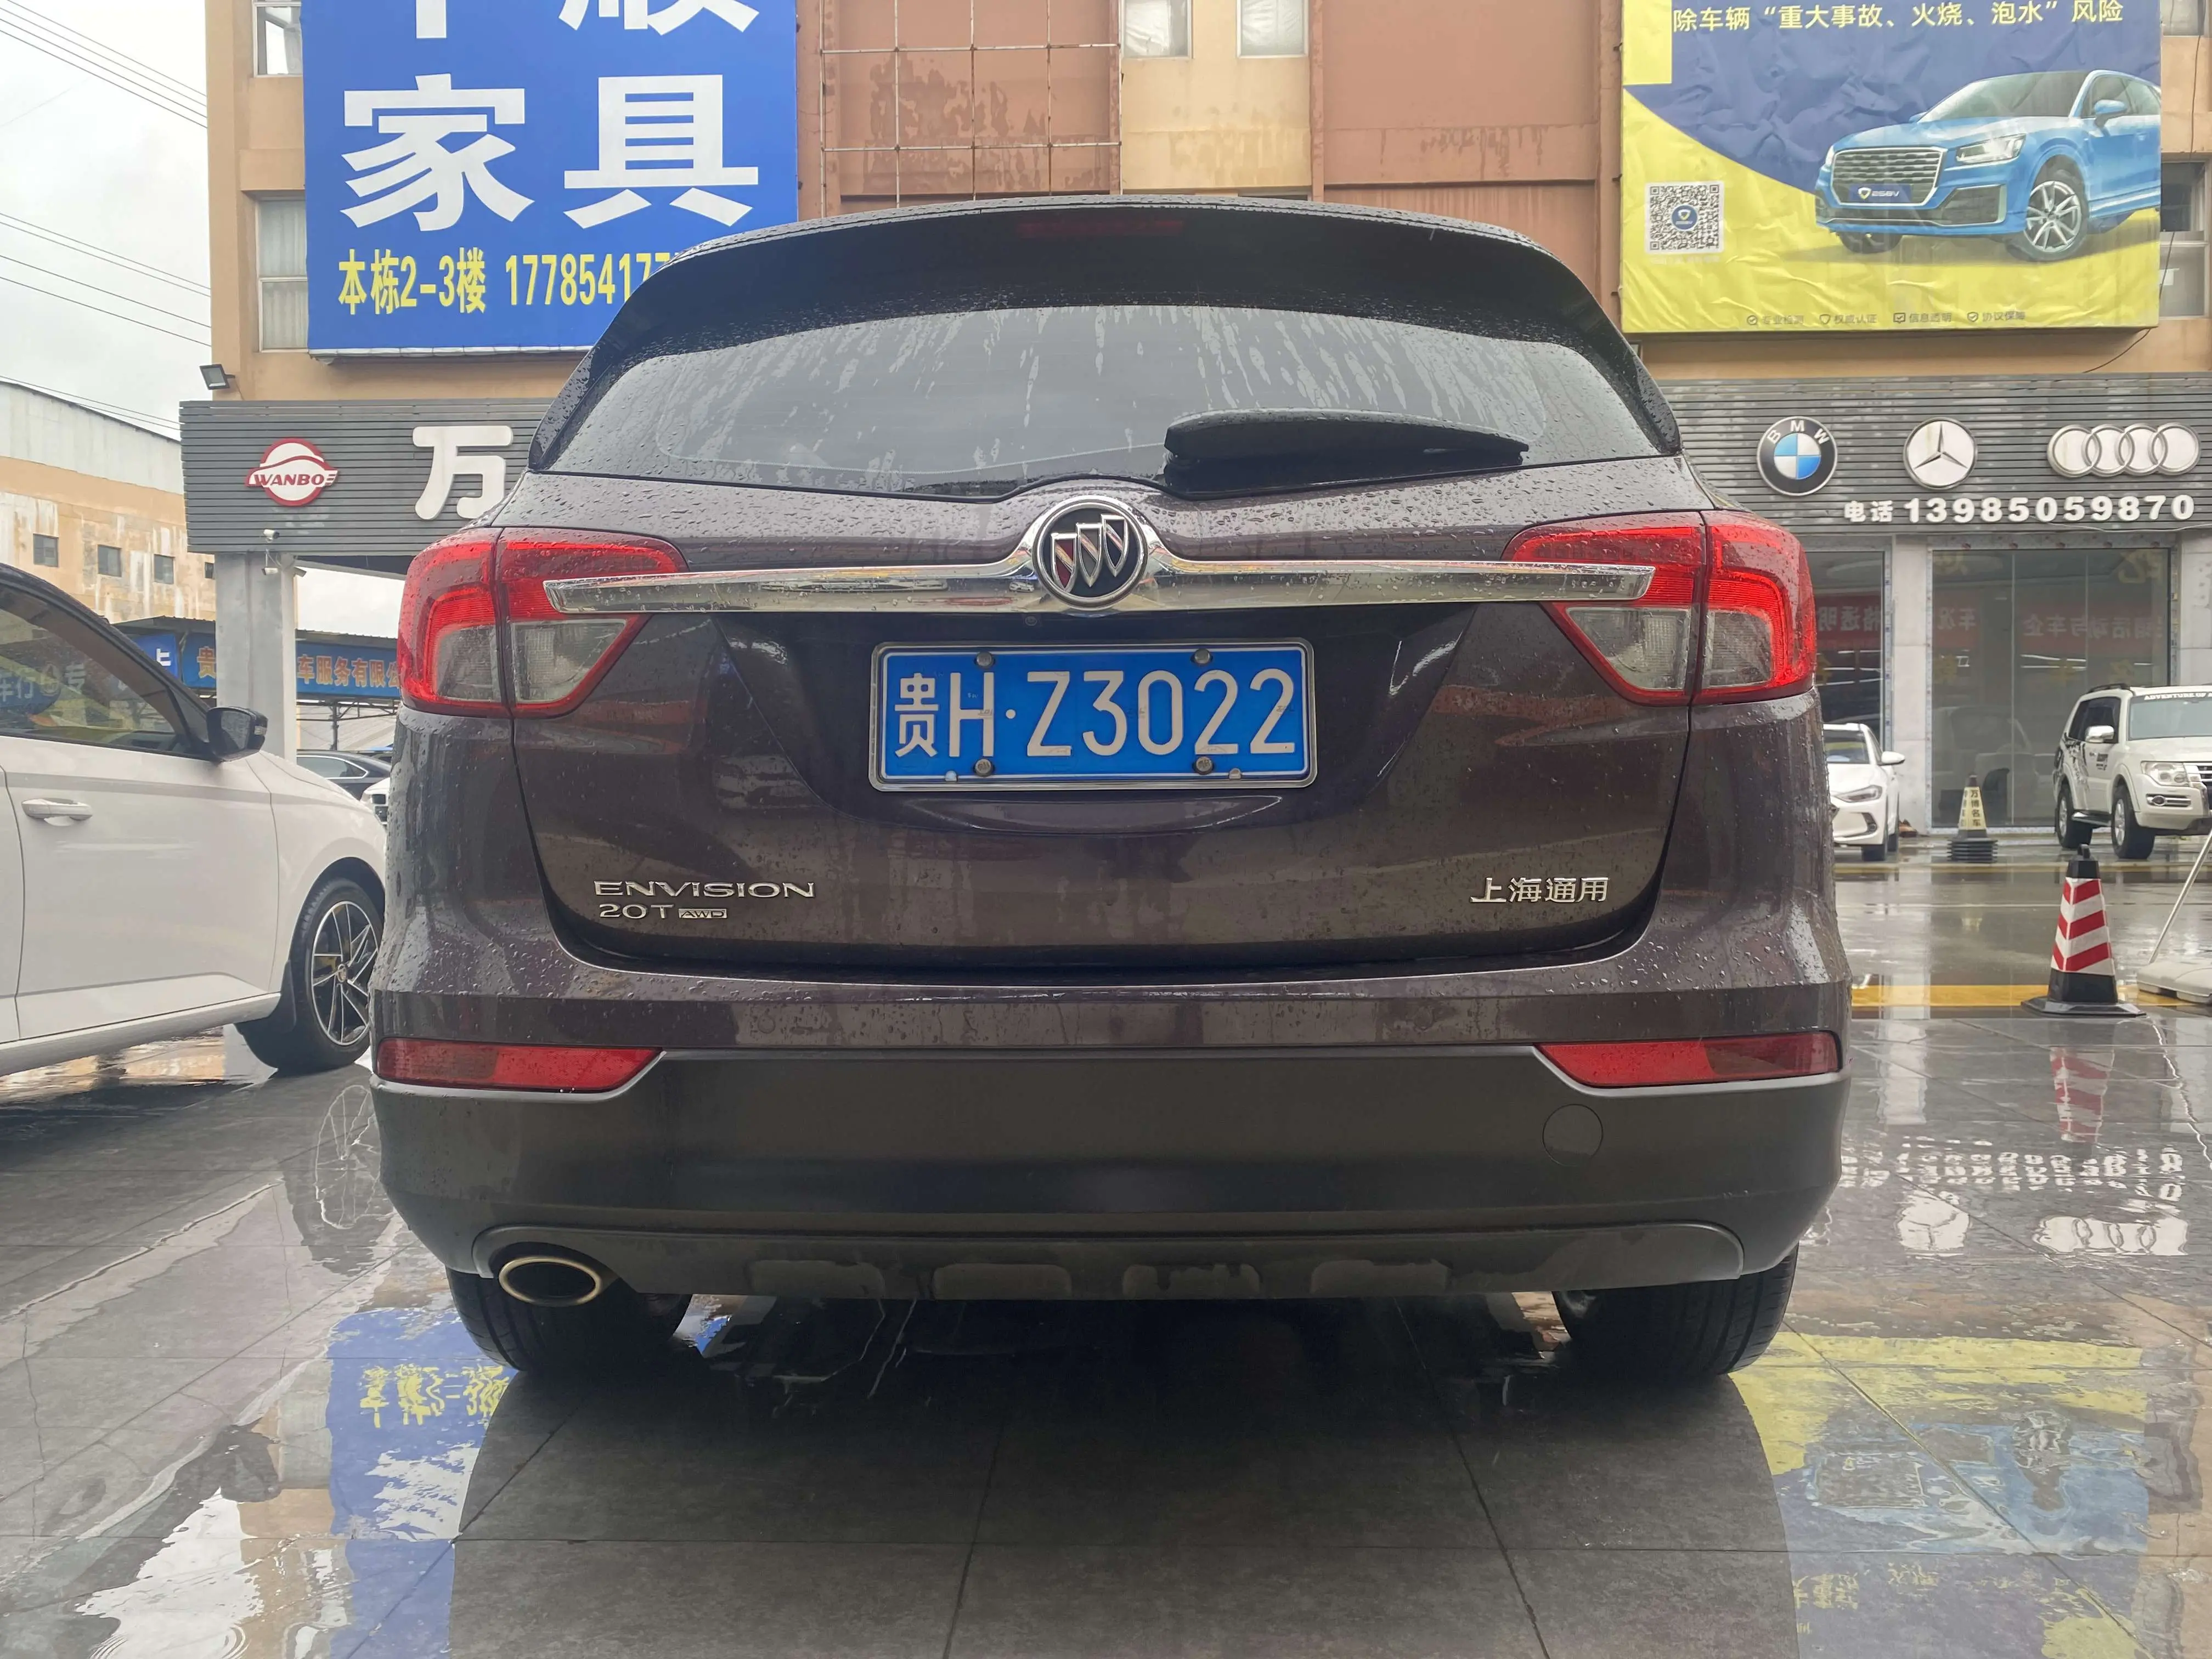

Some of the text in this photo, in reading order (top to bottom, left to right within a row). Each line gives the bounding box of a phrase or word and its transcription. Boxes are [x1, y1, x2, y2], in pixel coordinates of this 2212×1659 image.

[340, 73, 759, 232] 家具
[338, 247, 486, 315] 本栋2-3楼
[1767, 420, 1830, 445] BMW
[253, 473, 325, 486] WANBO
[413, 426, 514, 520] 万
[1843, 494, 2195, 523] 电话 13985059870
[594, 881, 815, 898] ENVISION
[1470, 877, 1609, 903] 上海通用
[599, 903, 727, 919] 20T AWD
